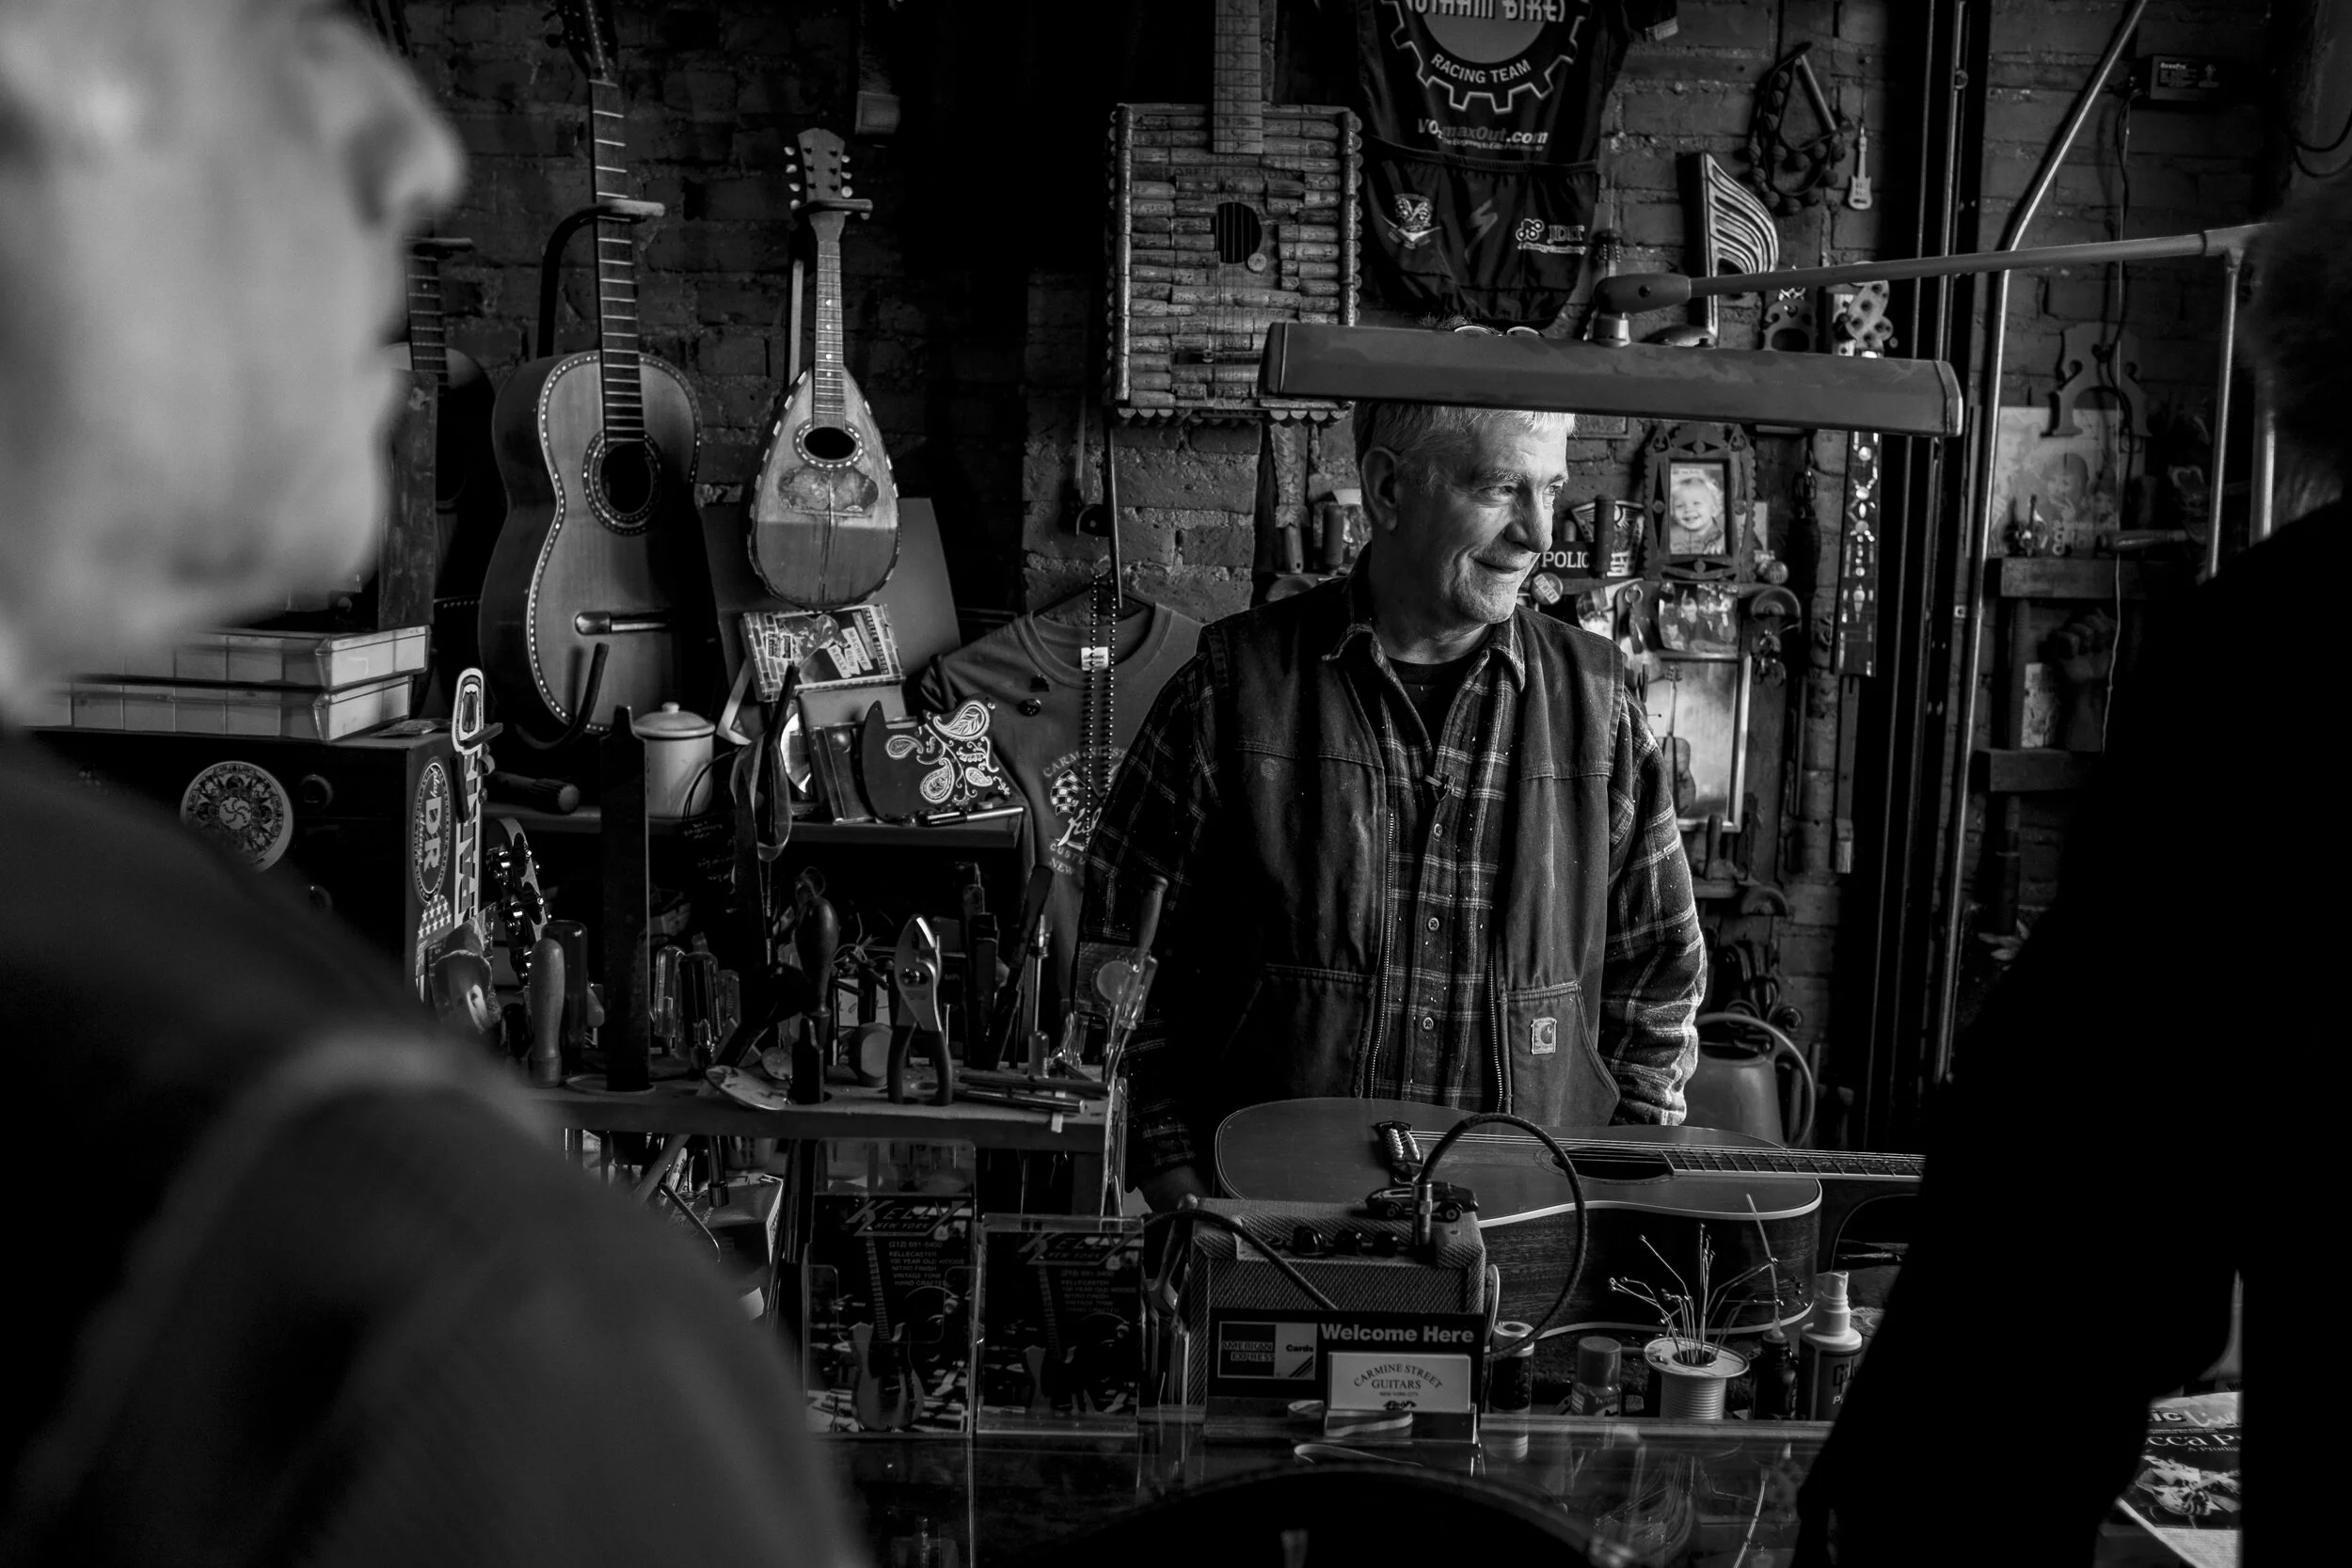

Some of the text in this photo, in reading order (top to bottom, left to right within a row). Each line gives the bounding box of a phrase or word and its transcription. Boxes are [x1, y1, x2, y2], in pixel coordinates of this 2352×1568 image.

[1430, 53, 1532, 84] RACING TEAM
[1541, 551, 1591, 568] POLIC
[848, 629, 867, 667] MACHINE
[831, 647, 848, 672] KELLY
[846, 649, 857, 668] GUN
[423, 796, 442, 873] DR
[845, 1200, 967, 1225] KELLY
[888, 1241, 907, 1249] (212)
[1320, 1323, 1475, 1343] Welcome Here
[1221, 1340, 1274, 1352] AMERICAN
[1286, 1344, 1313, 1353] Cards
[1231, 1352, 1276, 1362] EXPRESS
[1354, 1363, 1443, 1388] CARMINE STREET
[1371, 1379, 1422, 1389] GUITARS
